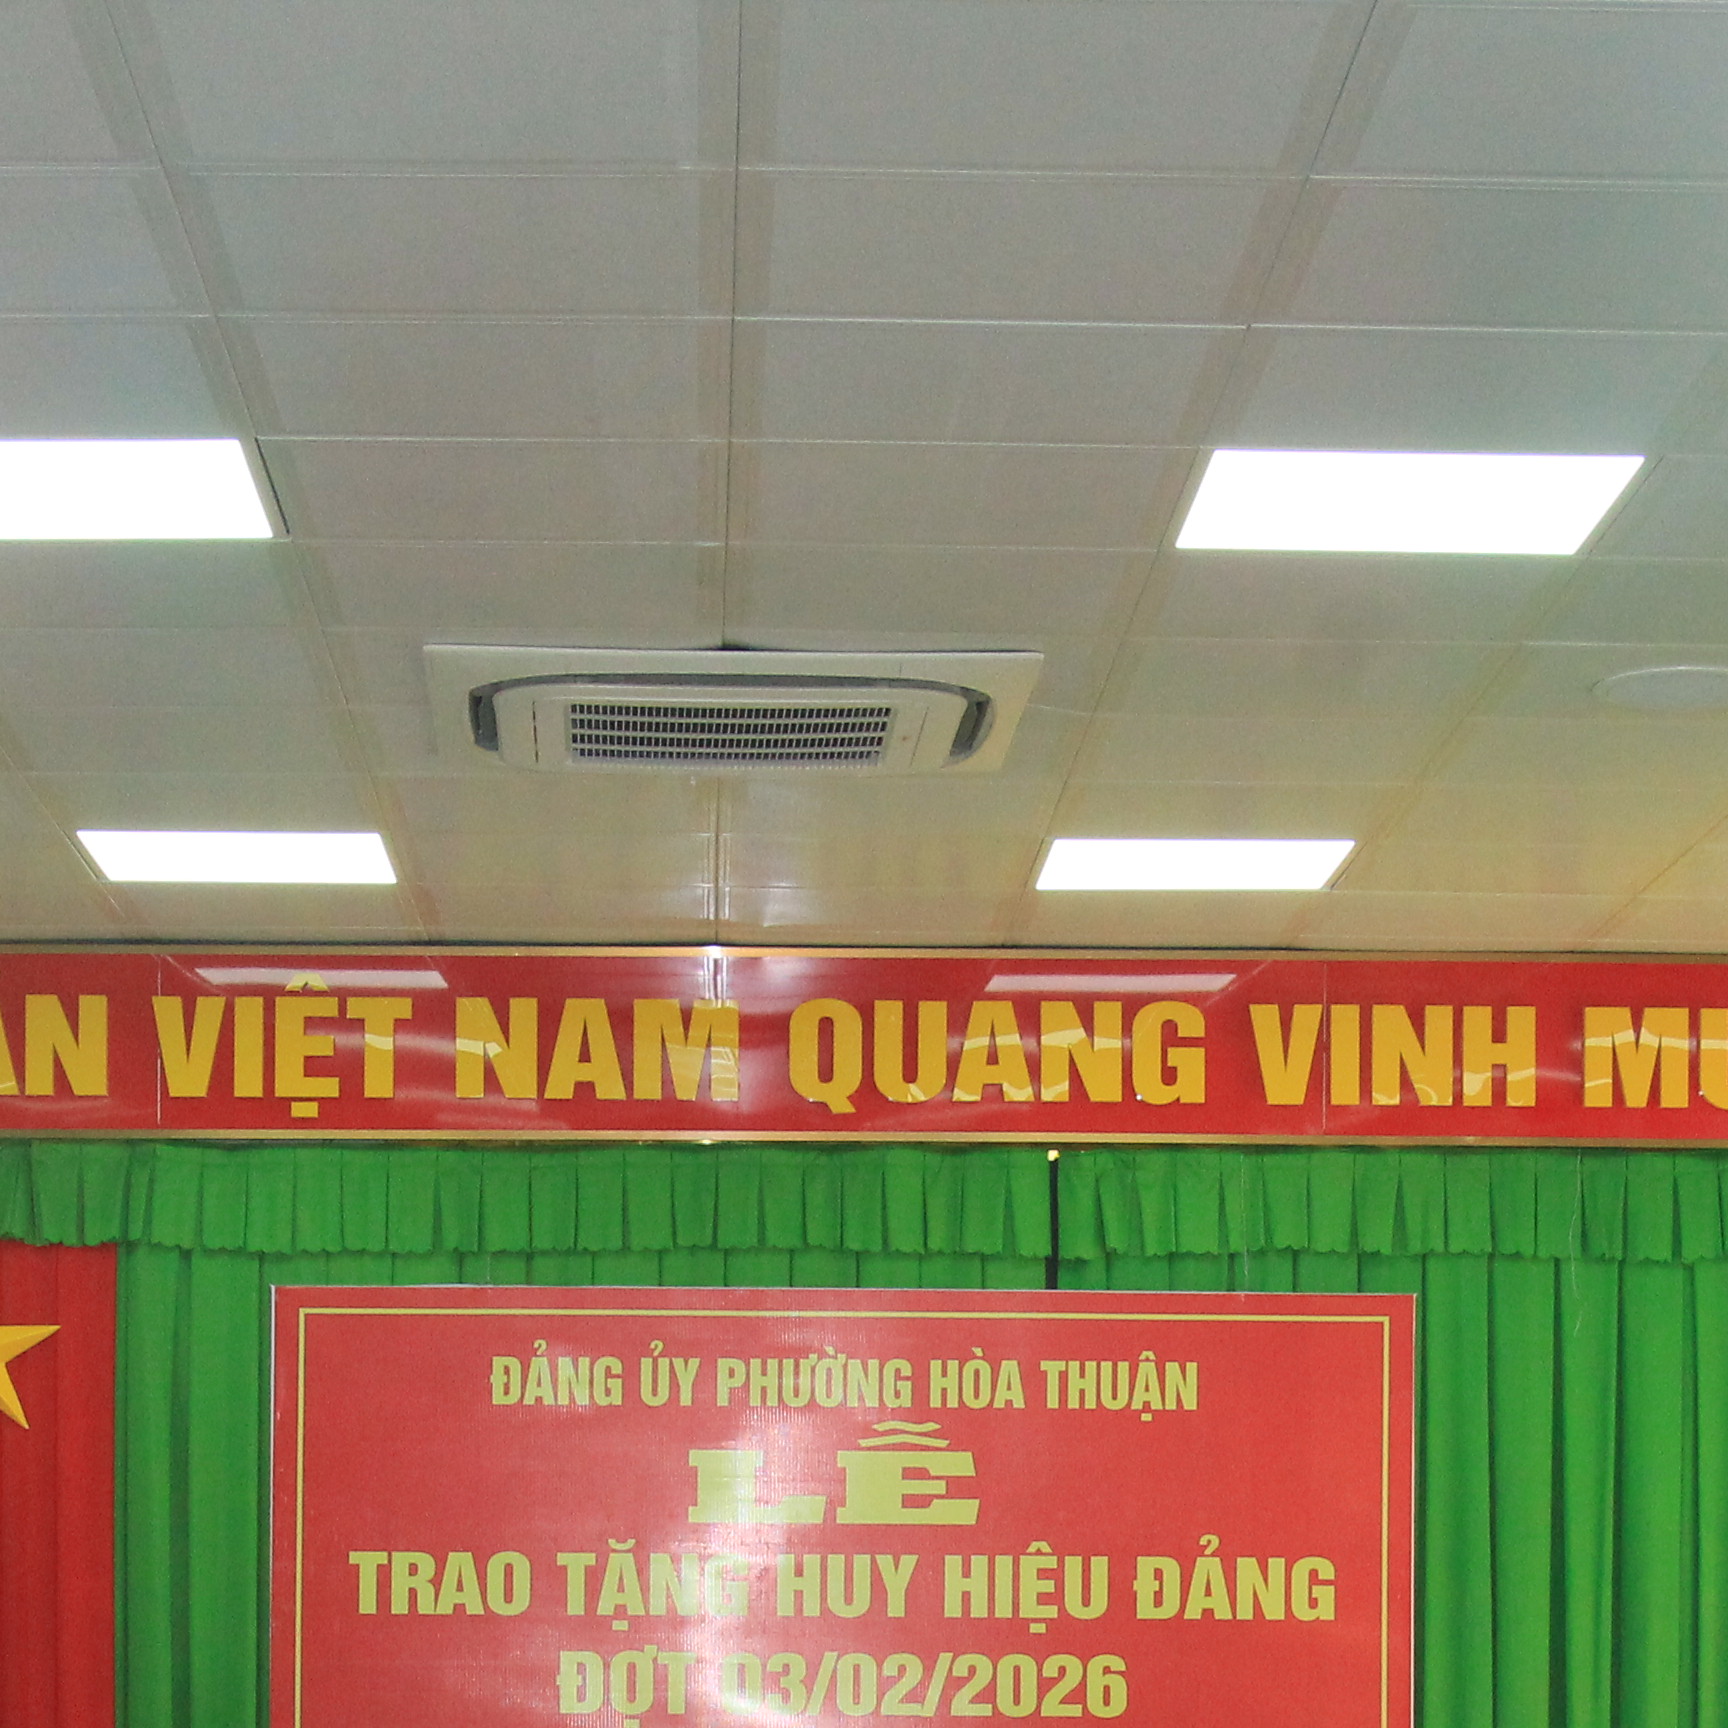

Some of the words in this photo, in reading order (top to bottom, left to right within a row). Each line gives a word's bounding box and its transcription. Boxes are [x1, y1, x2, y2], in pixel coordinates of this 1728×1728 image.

[150, 979, 414, 1119] VIỆT
[454, 998, 740, 1101] NAM
[787, 998, 1208, 1113] QUANG
[1251, 1002, 1536, 1107] VINH
[490, 1343, 623, 1407] ĐẢNG
[639, 1340, 700, 1407] ỦY
[716, 1347, 913, 1410] PHƯỜNG
[929, 1346, 1025, 1410] HÒA
[1040, 1350, 1198, 1422] THUẬN
[688, 1421, 981, 1527] LỄ
[348, 1550, 532, 1617] TRAO
[556, 1537, 750, 1632] TẶNG
[775, 1554, 919, 1619] HUY
[944, 1540, 1109, 1635] HIỆU
[1132, 1534, 1336, 1622] ĐẢNG
[720, 1651, 1129, 1719] 03/02/2026
